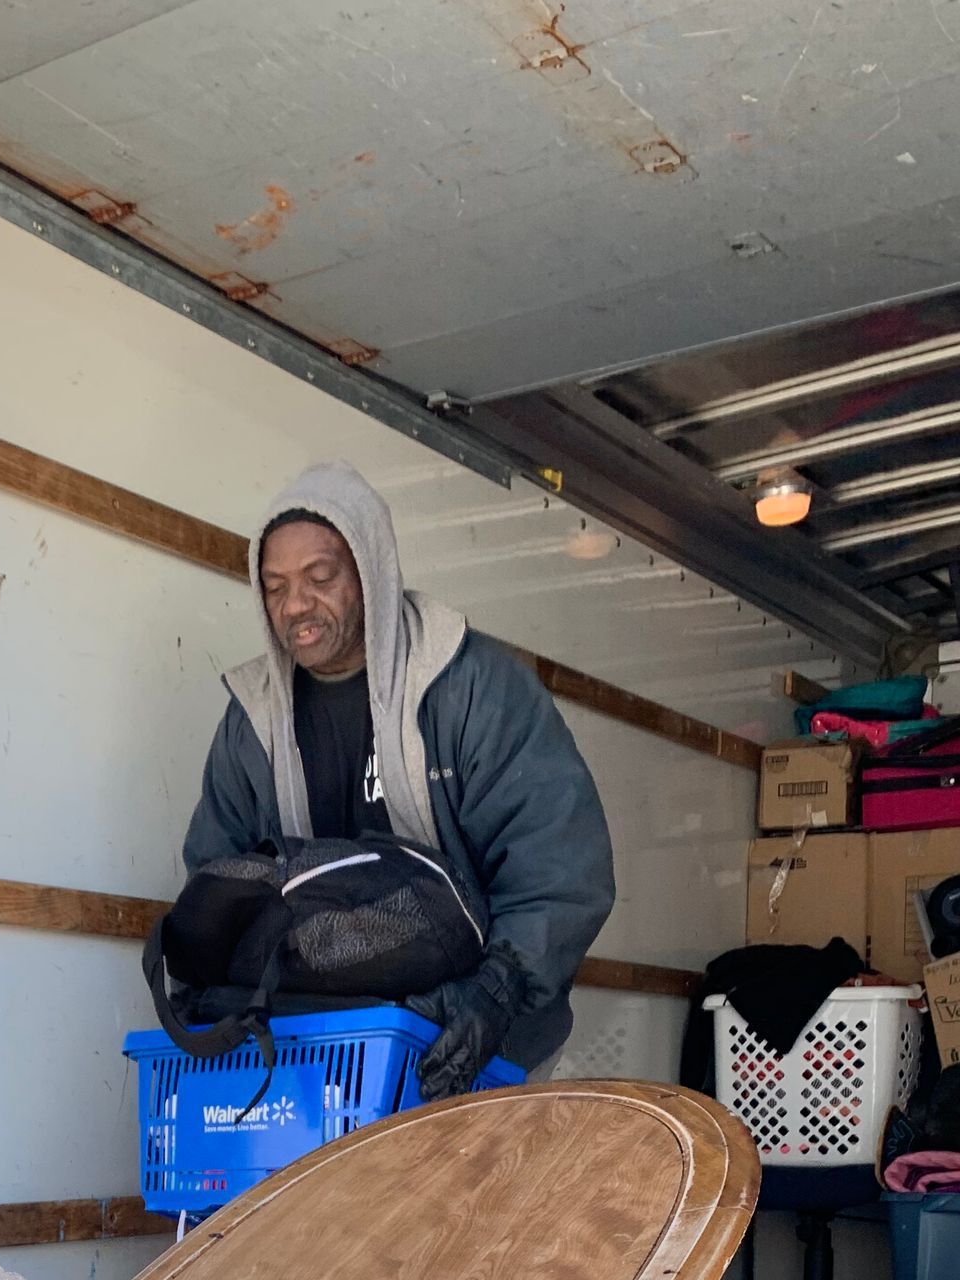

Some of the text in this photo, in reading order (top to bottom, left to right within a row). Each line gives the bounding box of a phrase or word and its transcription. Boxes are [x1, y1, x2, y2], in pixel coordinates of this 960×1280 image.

[203, 1102, 270, 1124] Walmart
[204, 1125, 216, 1133] Save
[217, 1125, 236, 1133] money.
[250, 1123, 269, 1131] better.
